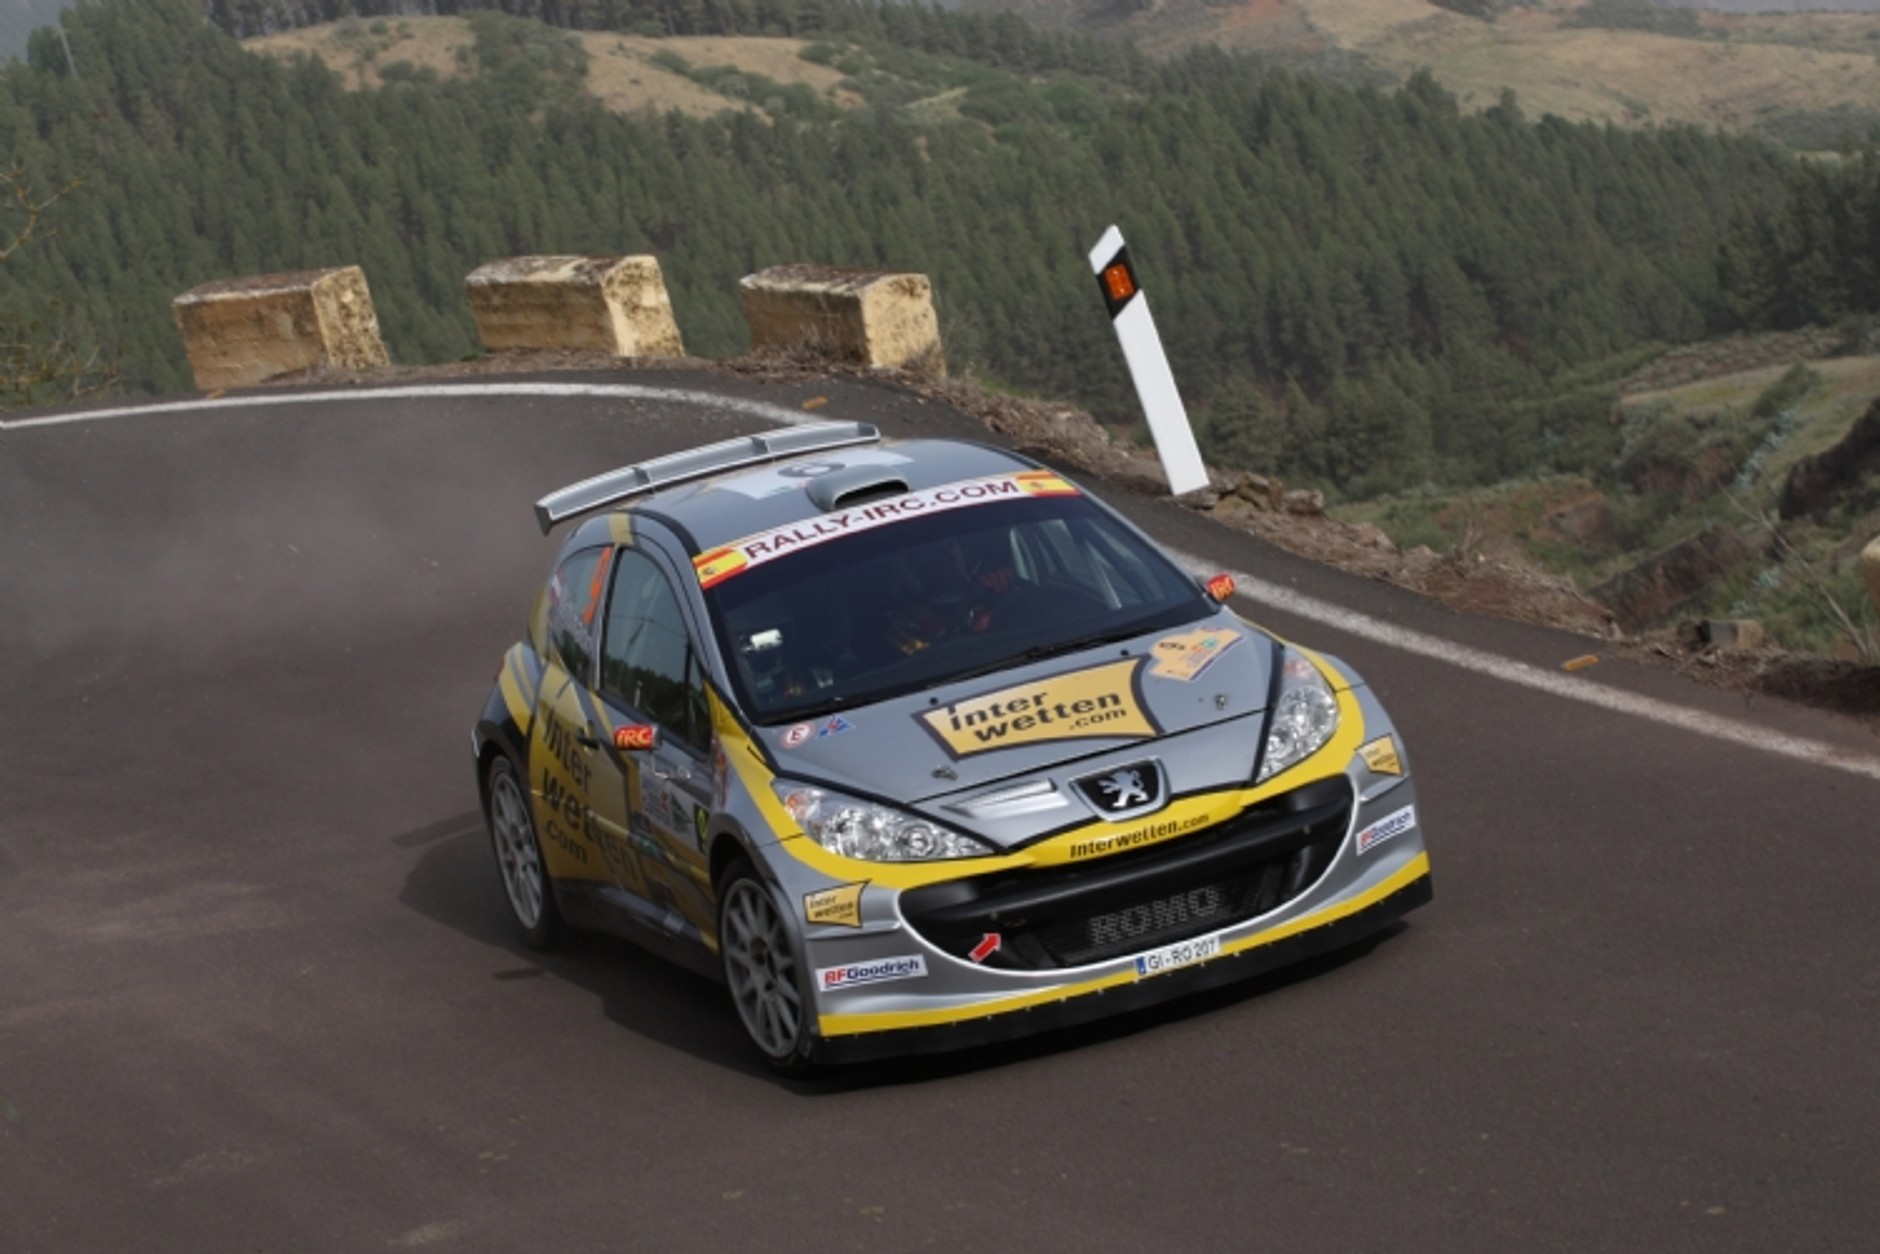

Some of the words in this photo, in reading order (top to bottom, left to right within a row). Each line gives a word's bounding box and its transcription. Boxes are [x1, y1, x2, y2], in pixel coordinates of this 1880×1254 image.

[743, 478, 1019, 562] RALLY-IRC.COM
[949, 691, 1050, 732] inter
[972, 691, 1122, 744] wetten
[1068, 707, 1128, 731] .com
[616, 727, 652, 748] IRC
[1069, 813, 1210, 859] Interwetten.com
[1088, 885, 1220, 945] ROMO
[1193, 938, 1216, 959] 207
[824, 959, 920, 985] BFGoodrich
